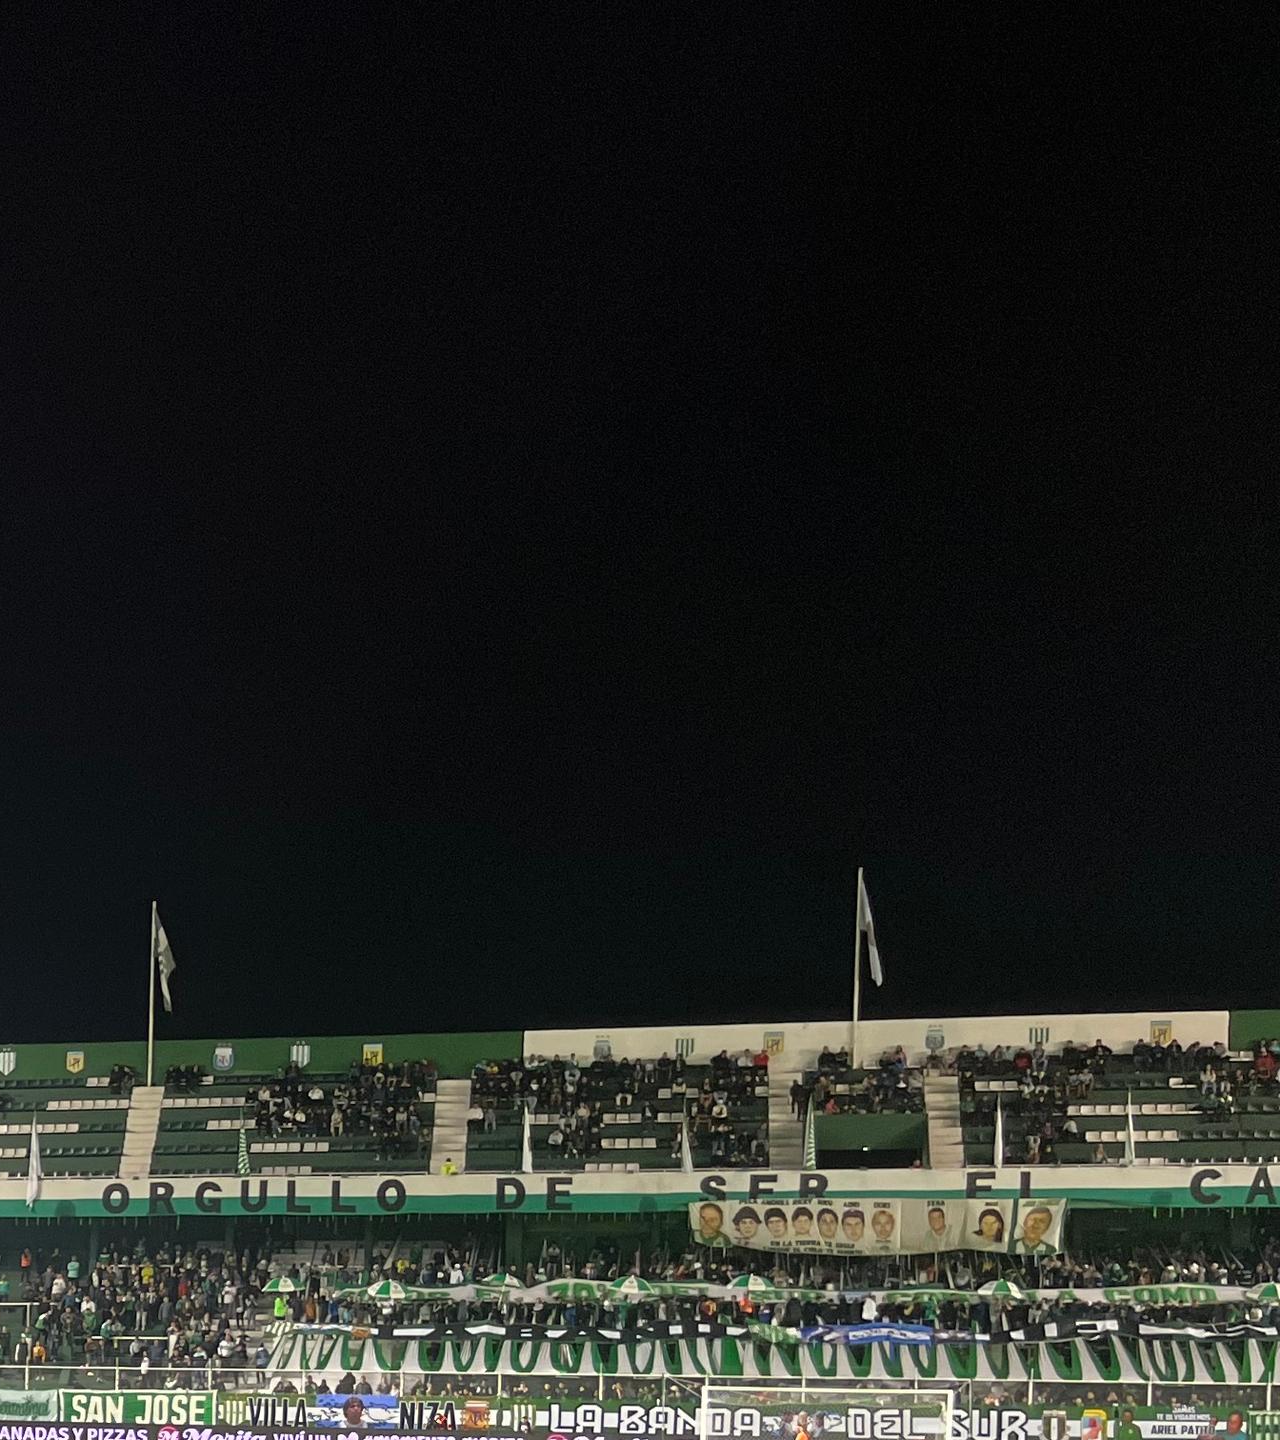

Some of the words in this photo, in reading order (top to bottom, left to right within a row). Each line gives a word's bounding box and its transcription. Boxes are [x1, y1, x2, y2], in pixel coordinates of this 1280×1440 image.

[102, 1177, 408, 1216] ORGULLO
[496, 1176, 573, 1212] DE
[70, 1394, 124, 1424] SAN
[135, 1394, 208, 1426] JOSE
[247, 1396, 308, 1428] VILLA
[399, 1400, 457, 1431] NIZA
[548, 1403, 603, 1434] LA
[619, 1404, 761, 1437] BANDA
[847, 1408, 926, 1440] DEL
[70, 1427, 84, 1440] Y
[1150, 1425, 1178, 1435] ARIEL
[1180, 1425, 1216, 1435] PATITO
